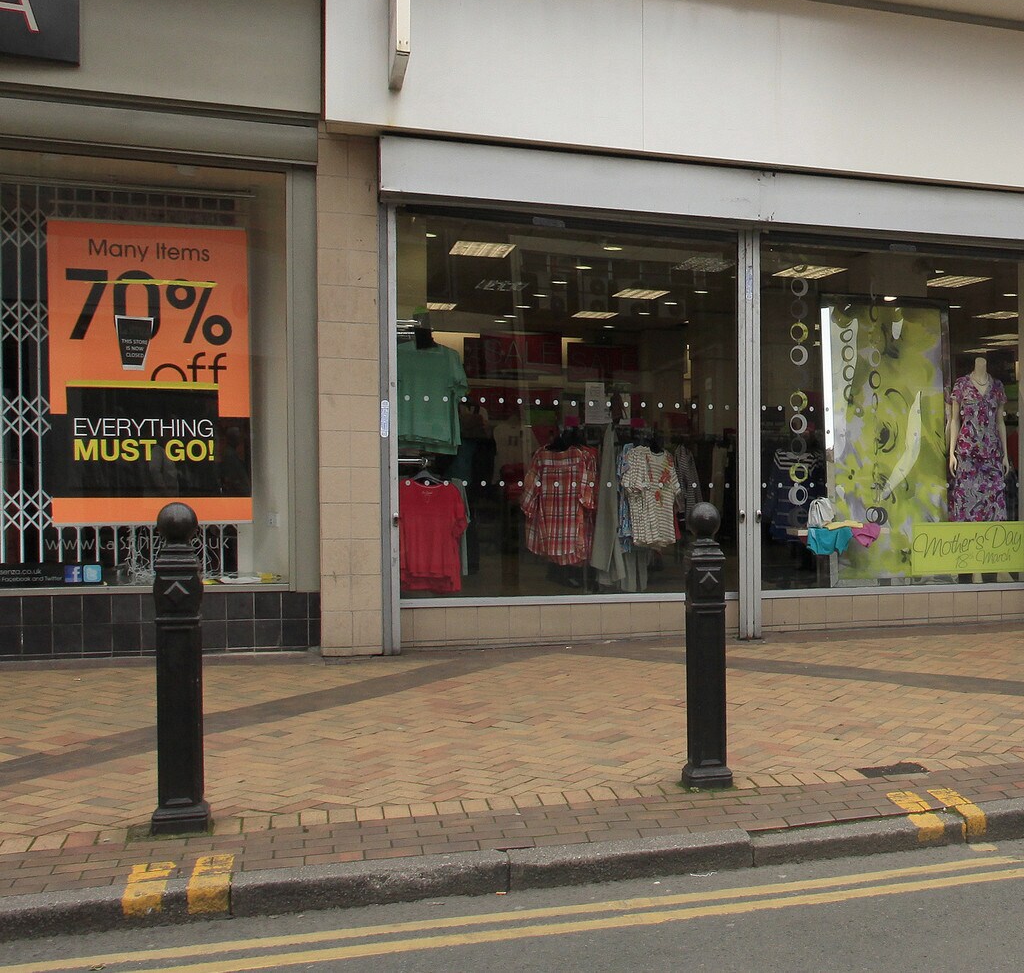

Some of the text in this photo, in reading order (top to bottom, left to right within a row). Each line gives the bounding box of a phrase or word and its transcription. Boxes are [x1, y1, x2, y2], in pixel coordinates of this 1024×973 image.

[88, 238, 210, 263] Many Items
[65, 268, 232, 346] 70%
[73, 418, 214, 438] EVERYTHING
[73, 439, 215, 461] MUST GO!
[912, 524, 1022, 559] Mother's Day
